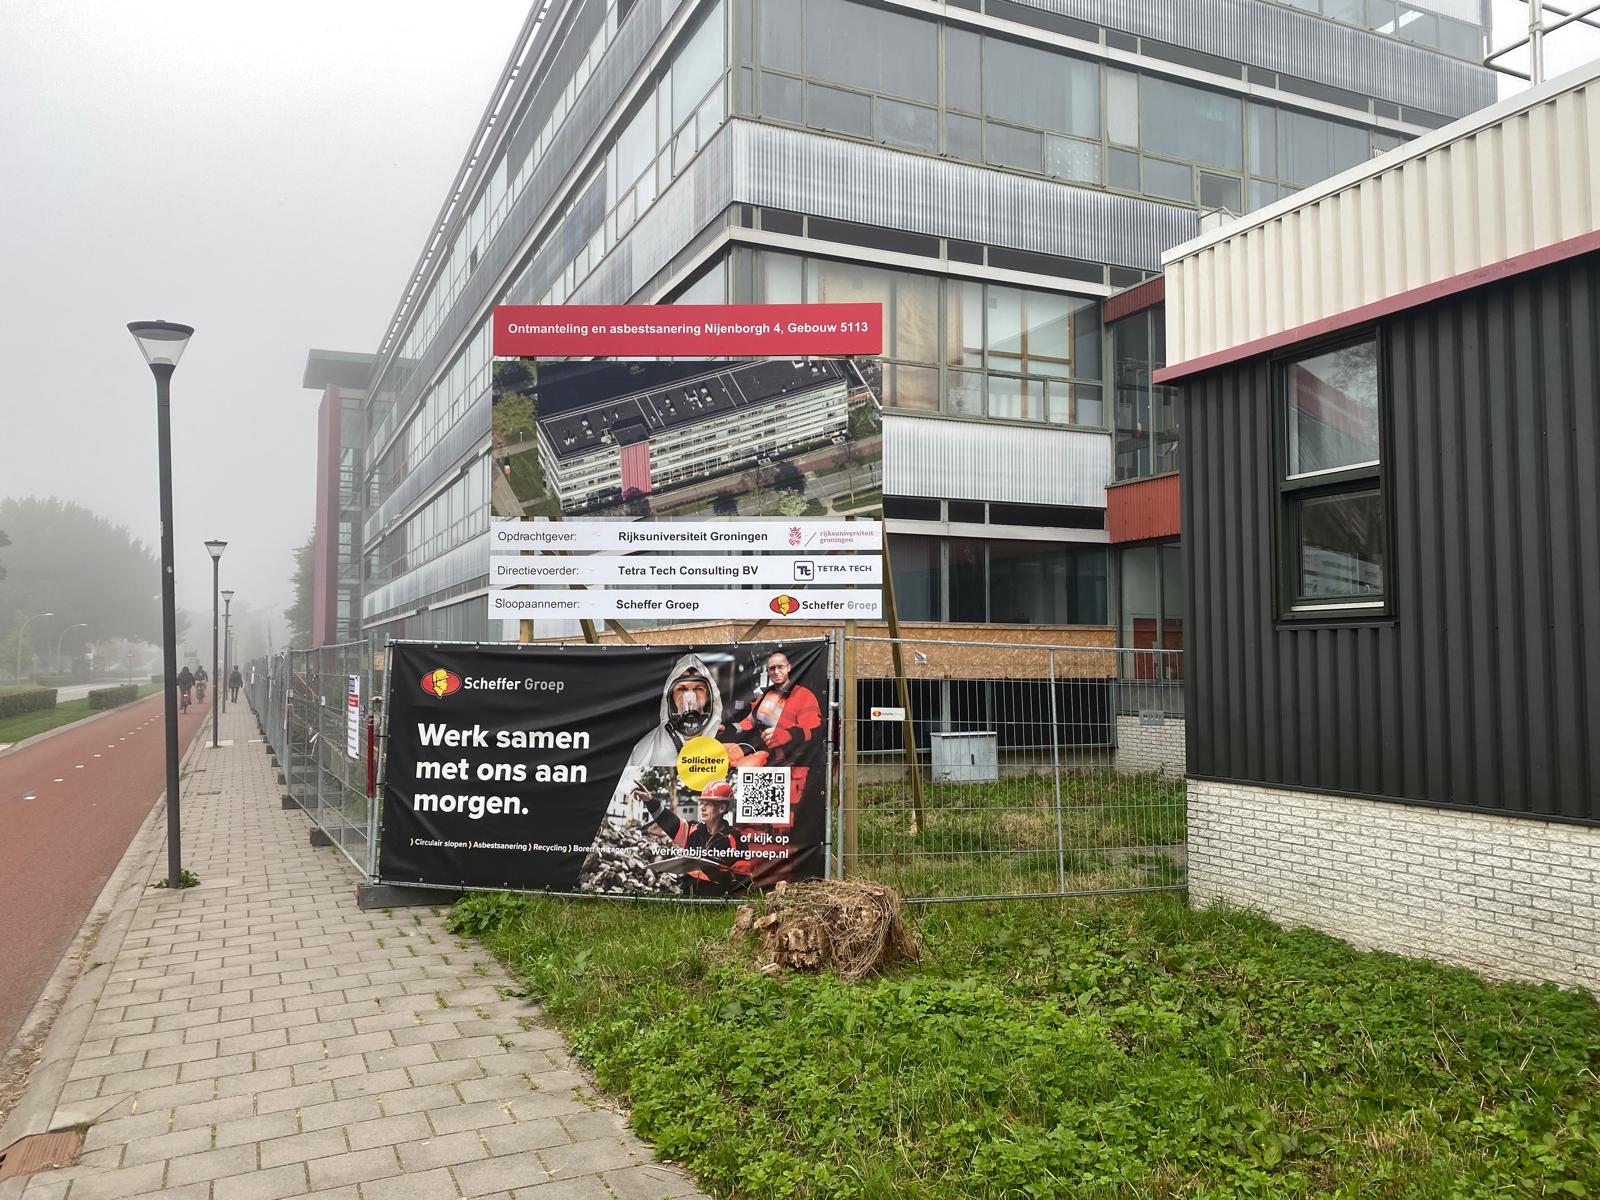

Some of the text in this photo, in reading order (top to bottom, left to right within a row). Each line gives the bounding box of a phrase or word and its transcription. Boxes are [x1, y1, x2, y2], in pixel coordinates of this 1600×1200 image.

[508, 321, 869, 336] Ontmanteling en asbestsanering Nijenborgh 4, Gebouw 5113
[498, 531, 768, 544] Opdrachtgever: Rijksuniversiteit Groningen
[819, 530, 874, 538] rijksuniversiteit
[497, 566, 759, 577] Directievoerder: Tetra Tech Consulting BV
[495, 598, 700, 611] Sloopaannemer: Scheffer Groep
[802, 600, 878, 612] Scheffer Groep
[464, 677, 565, 694] Scheffer Groep
[417, 723, 590, 750] Werk samen
[681, 756, 725, 765] Solliciteer
[415, 758, 588, 783] met ons aan
[688, 765, 717, 773] direct!
[413, 792, 529, 820] morgen.
[415, 838, 443, 847] Circulair
[444, 840, 467, 849] slopen
[473, 841, 528, 851] Asbestsanering
[533, 844, 567, 853] Recycling
[573, 844, 594, 852] Boren
[740, 833, 790, 845] of kijk op
[651, 847, 789, 860] werkenbijscheffergroep.nl
